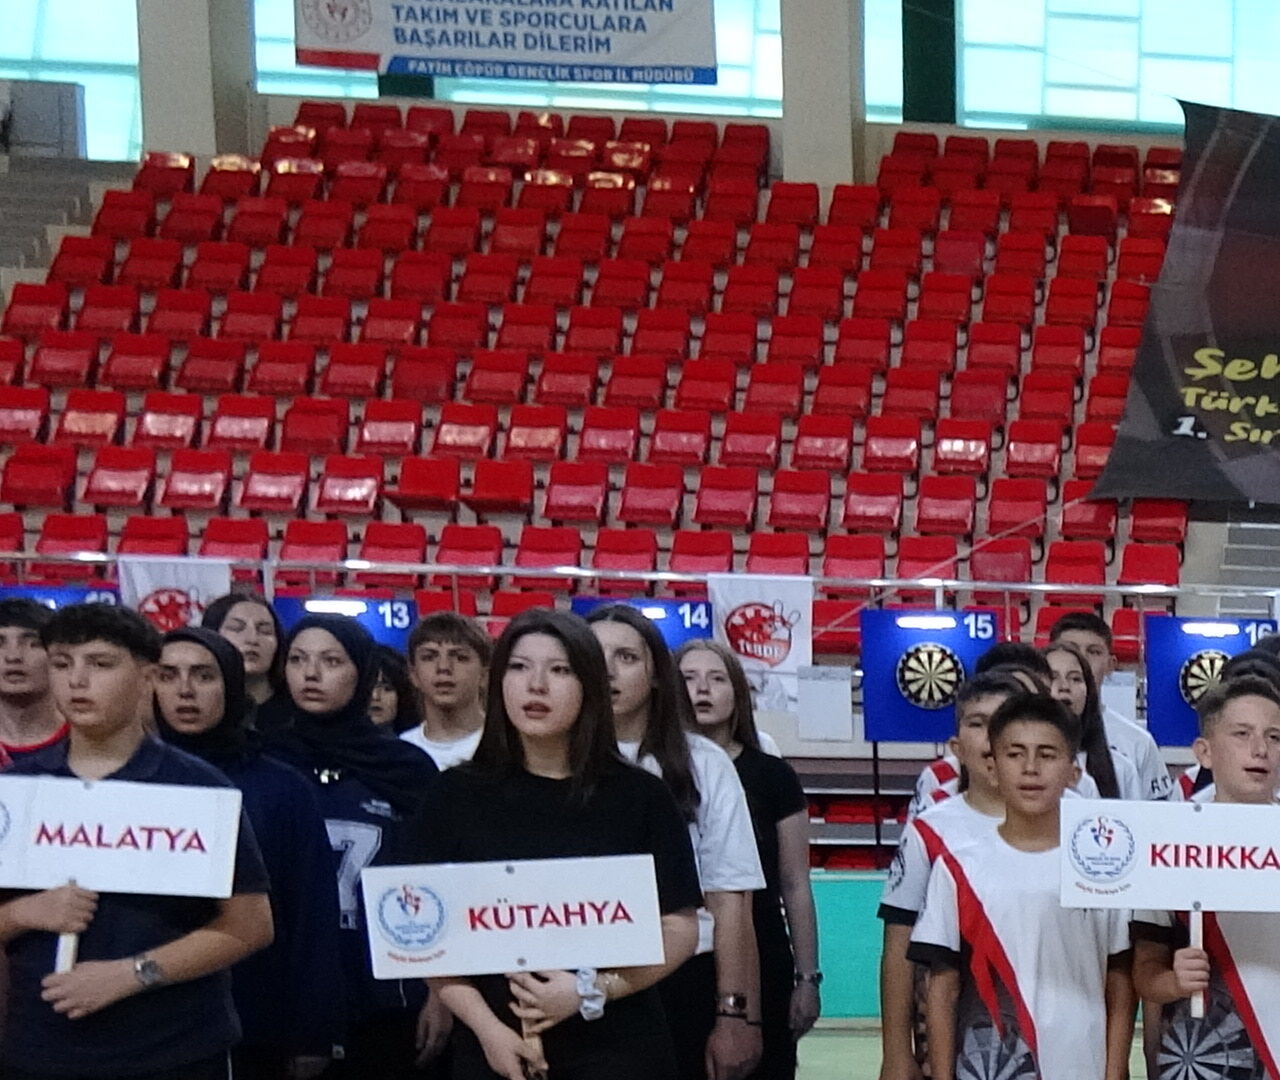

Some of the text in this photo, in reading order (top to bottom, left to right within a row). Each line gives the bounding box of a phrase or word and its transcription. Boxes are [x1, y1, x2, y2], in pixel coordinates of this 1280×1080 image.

[392, 5, 647, 33] TAKIM VE SPORCULARA
[393, 27, 611, 53] BAŞARILAR DİLERİM
[1172, 415, 1208, 439] 1.
[379, 602, 410, 628] 13
[678, 603, 708, 629] 14
[963, 614, 993, 639] 15
[35, 823, 207, 854] MALATYA
[324, 819, 383, 930] 7
[469, 897, 634, 931] KÜTAHYA
